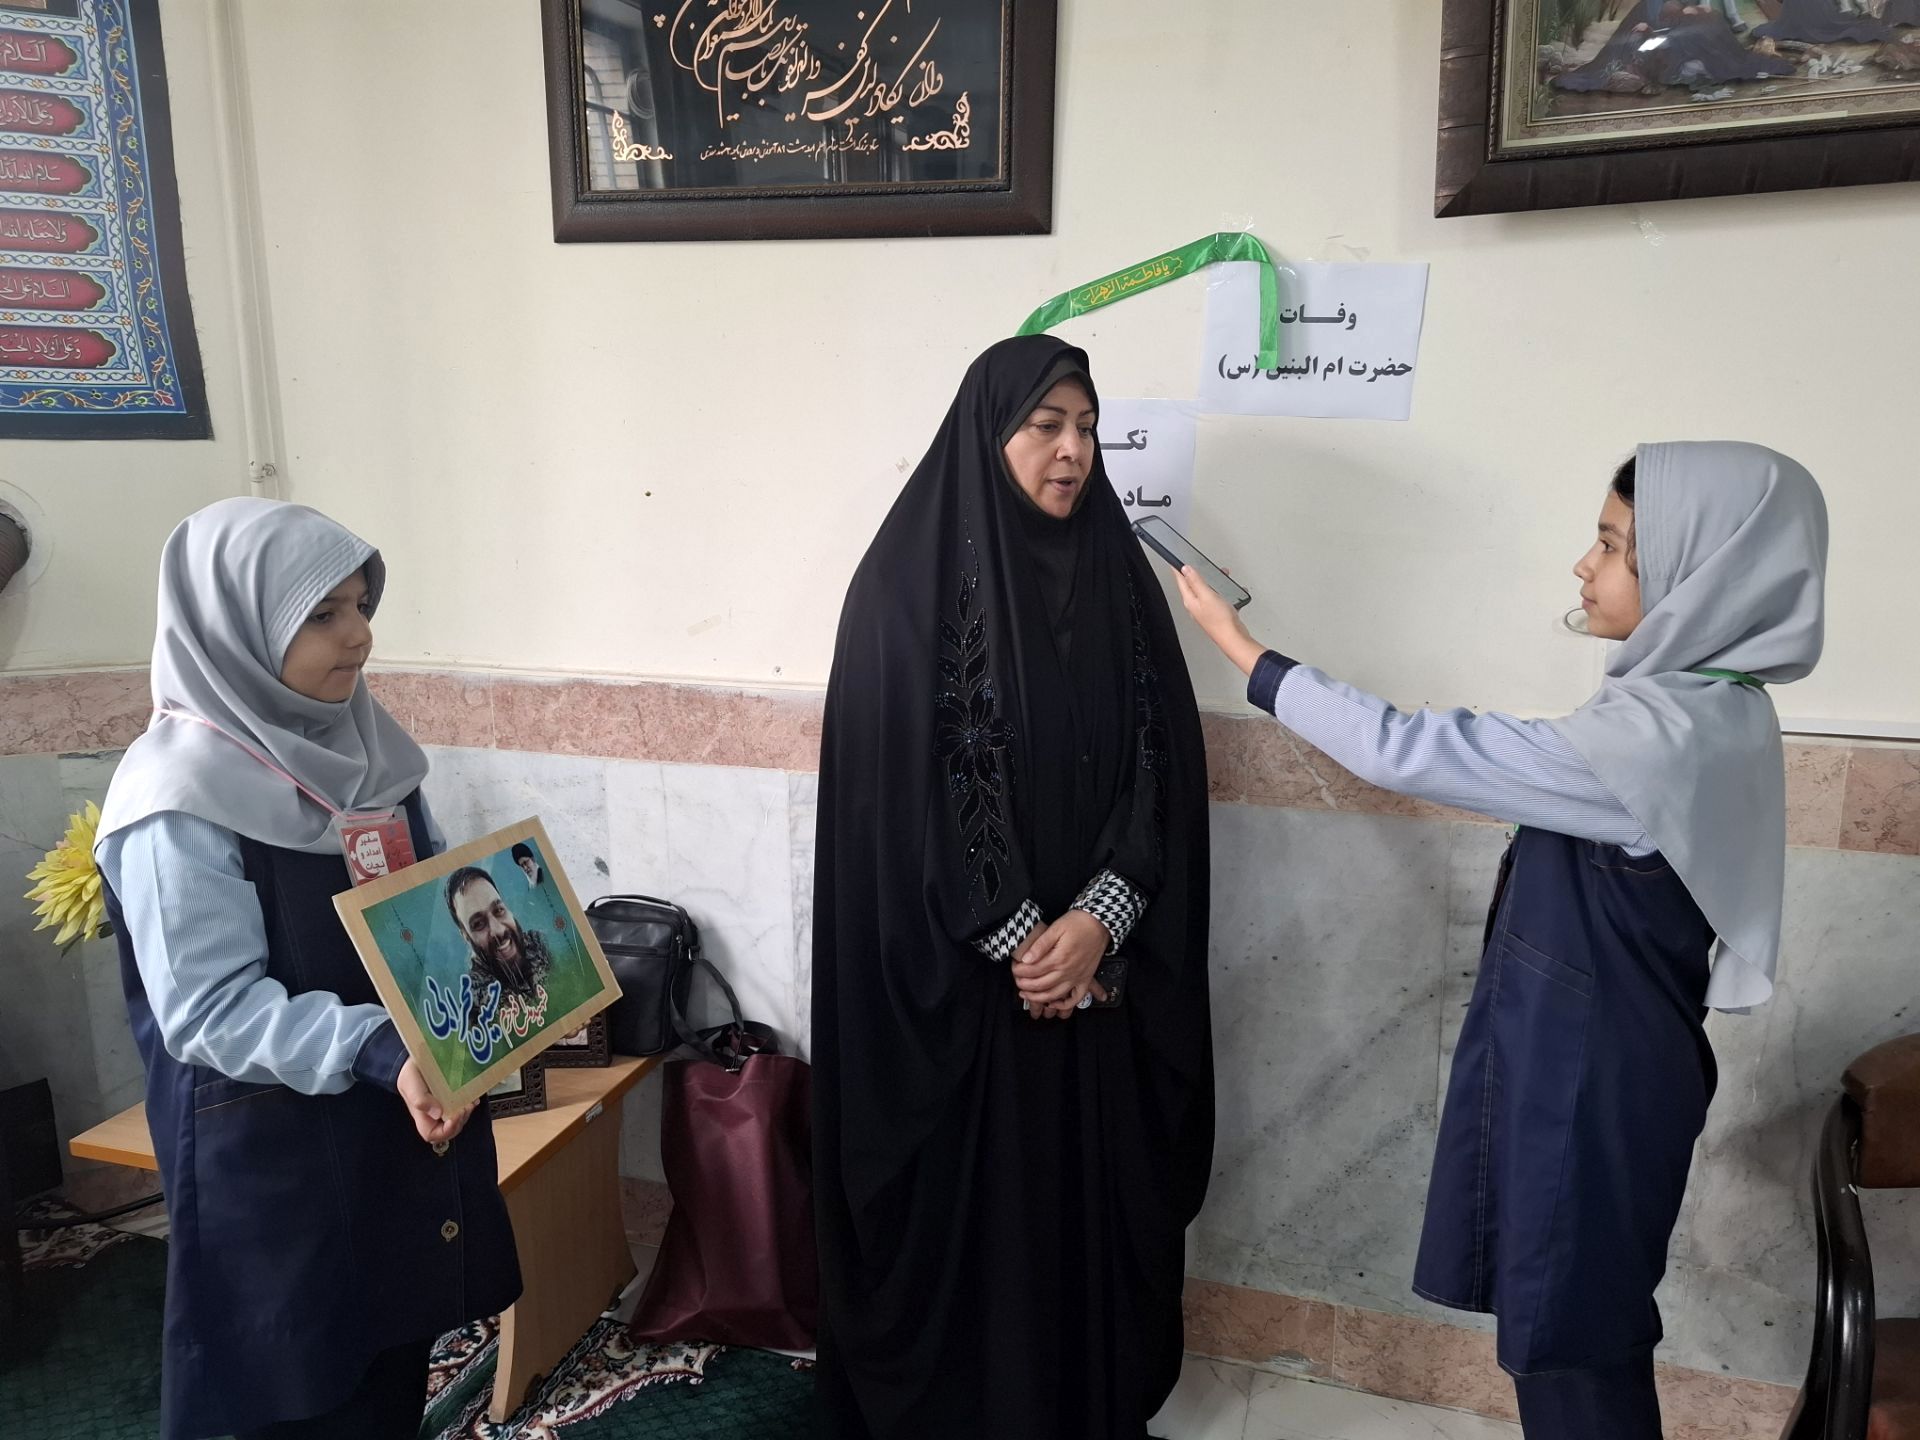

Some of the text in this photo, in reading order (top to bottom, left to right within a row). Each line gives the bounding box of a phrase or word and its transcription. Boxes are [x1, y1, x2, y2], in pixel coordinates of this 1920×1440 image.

[1279, 302, 1357, 330] وفات
[1322, 356, 1344, 381] ام
[1348, 357, 1413, 383] حضرت
[1123, 485, 1172, 507] ماد
[360, 836, 378, 847] سفیر
[423, 973, 474, 1042] محرابی
[467, 980, 502, 1064] حسین
